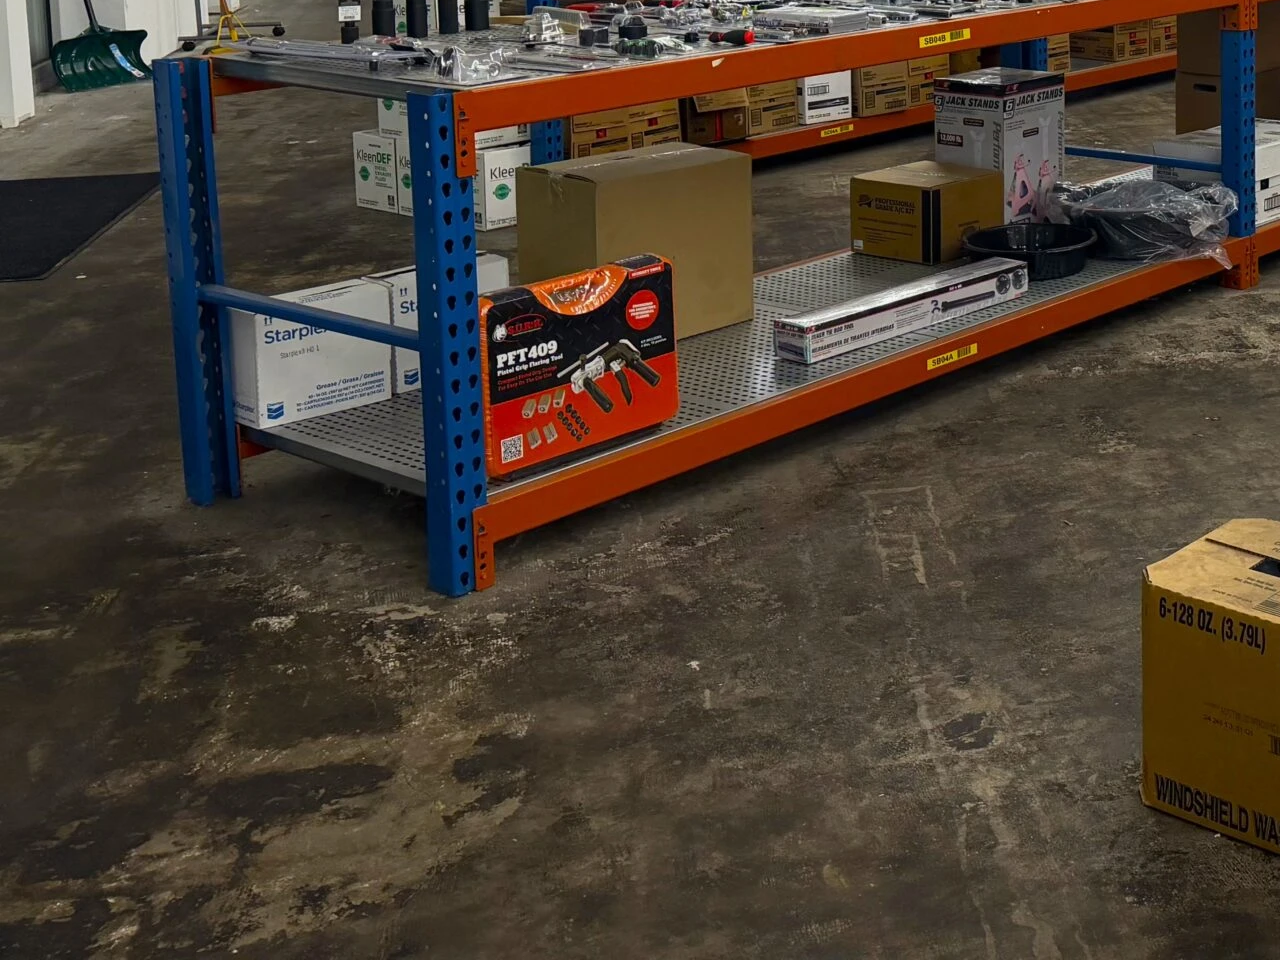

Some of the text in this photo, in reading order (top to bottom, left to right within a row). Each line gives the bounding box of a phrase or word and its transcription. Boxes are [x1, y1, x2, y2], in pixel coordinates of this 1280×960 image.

[946, 96, 1000, 110] JACK STANDS
[1005, 101, 1014, 111] 6
[1016, 87, 1063, 107] JACK STANDS
[356, 148, 392, 165] KleenDEF
[496, 340, 558, 369] PFT409
[931, 354, 954, 367] SB04A
[497, 367, 514, 377] Pistol
[529, 358, 550, 368] Flaring
[551, 353, 563, 361] Tool
[316, 381, 338, 391] Grease
[1158, 597, 1194, 628] 6-128
[1197, 607, 1217, 635] OZ.
[1221, 614, 1267, 656] (3.79L)
[1153, 773, 1250, 834] WINDSHIELD
